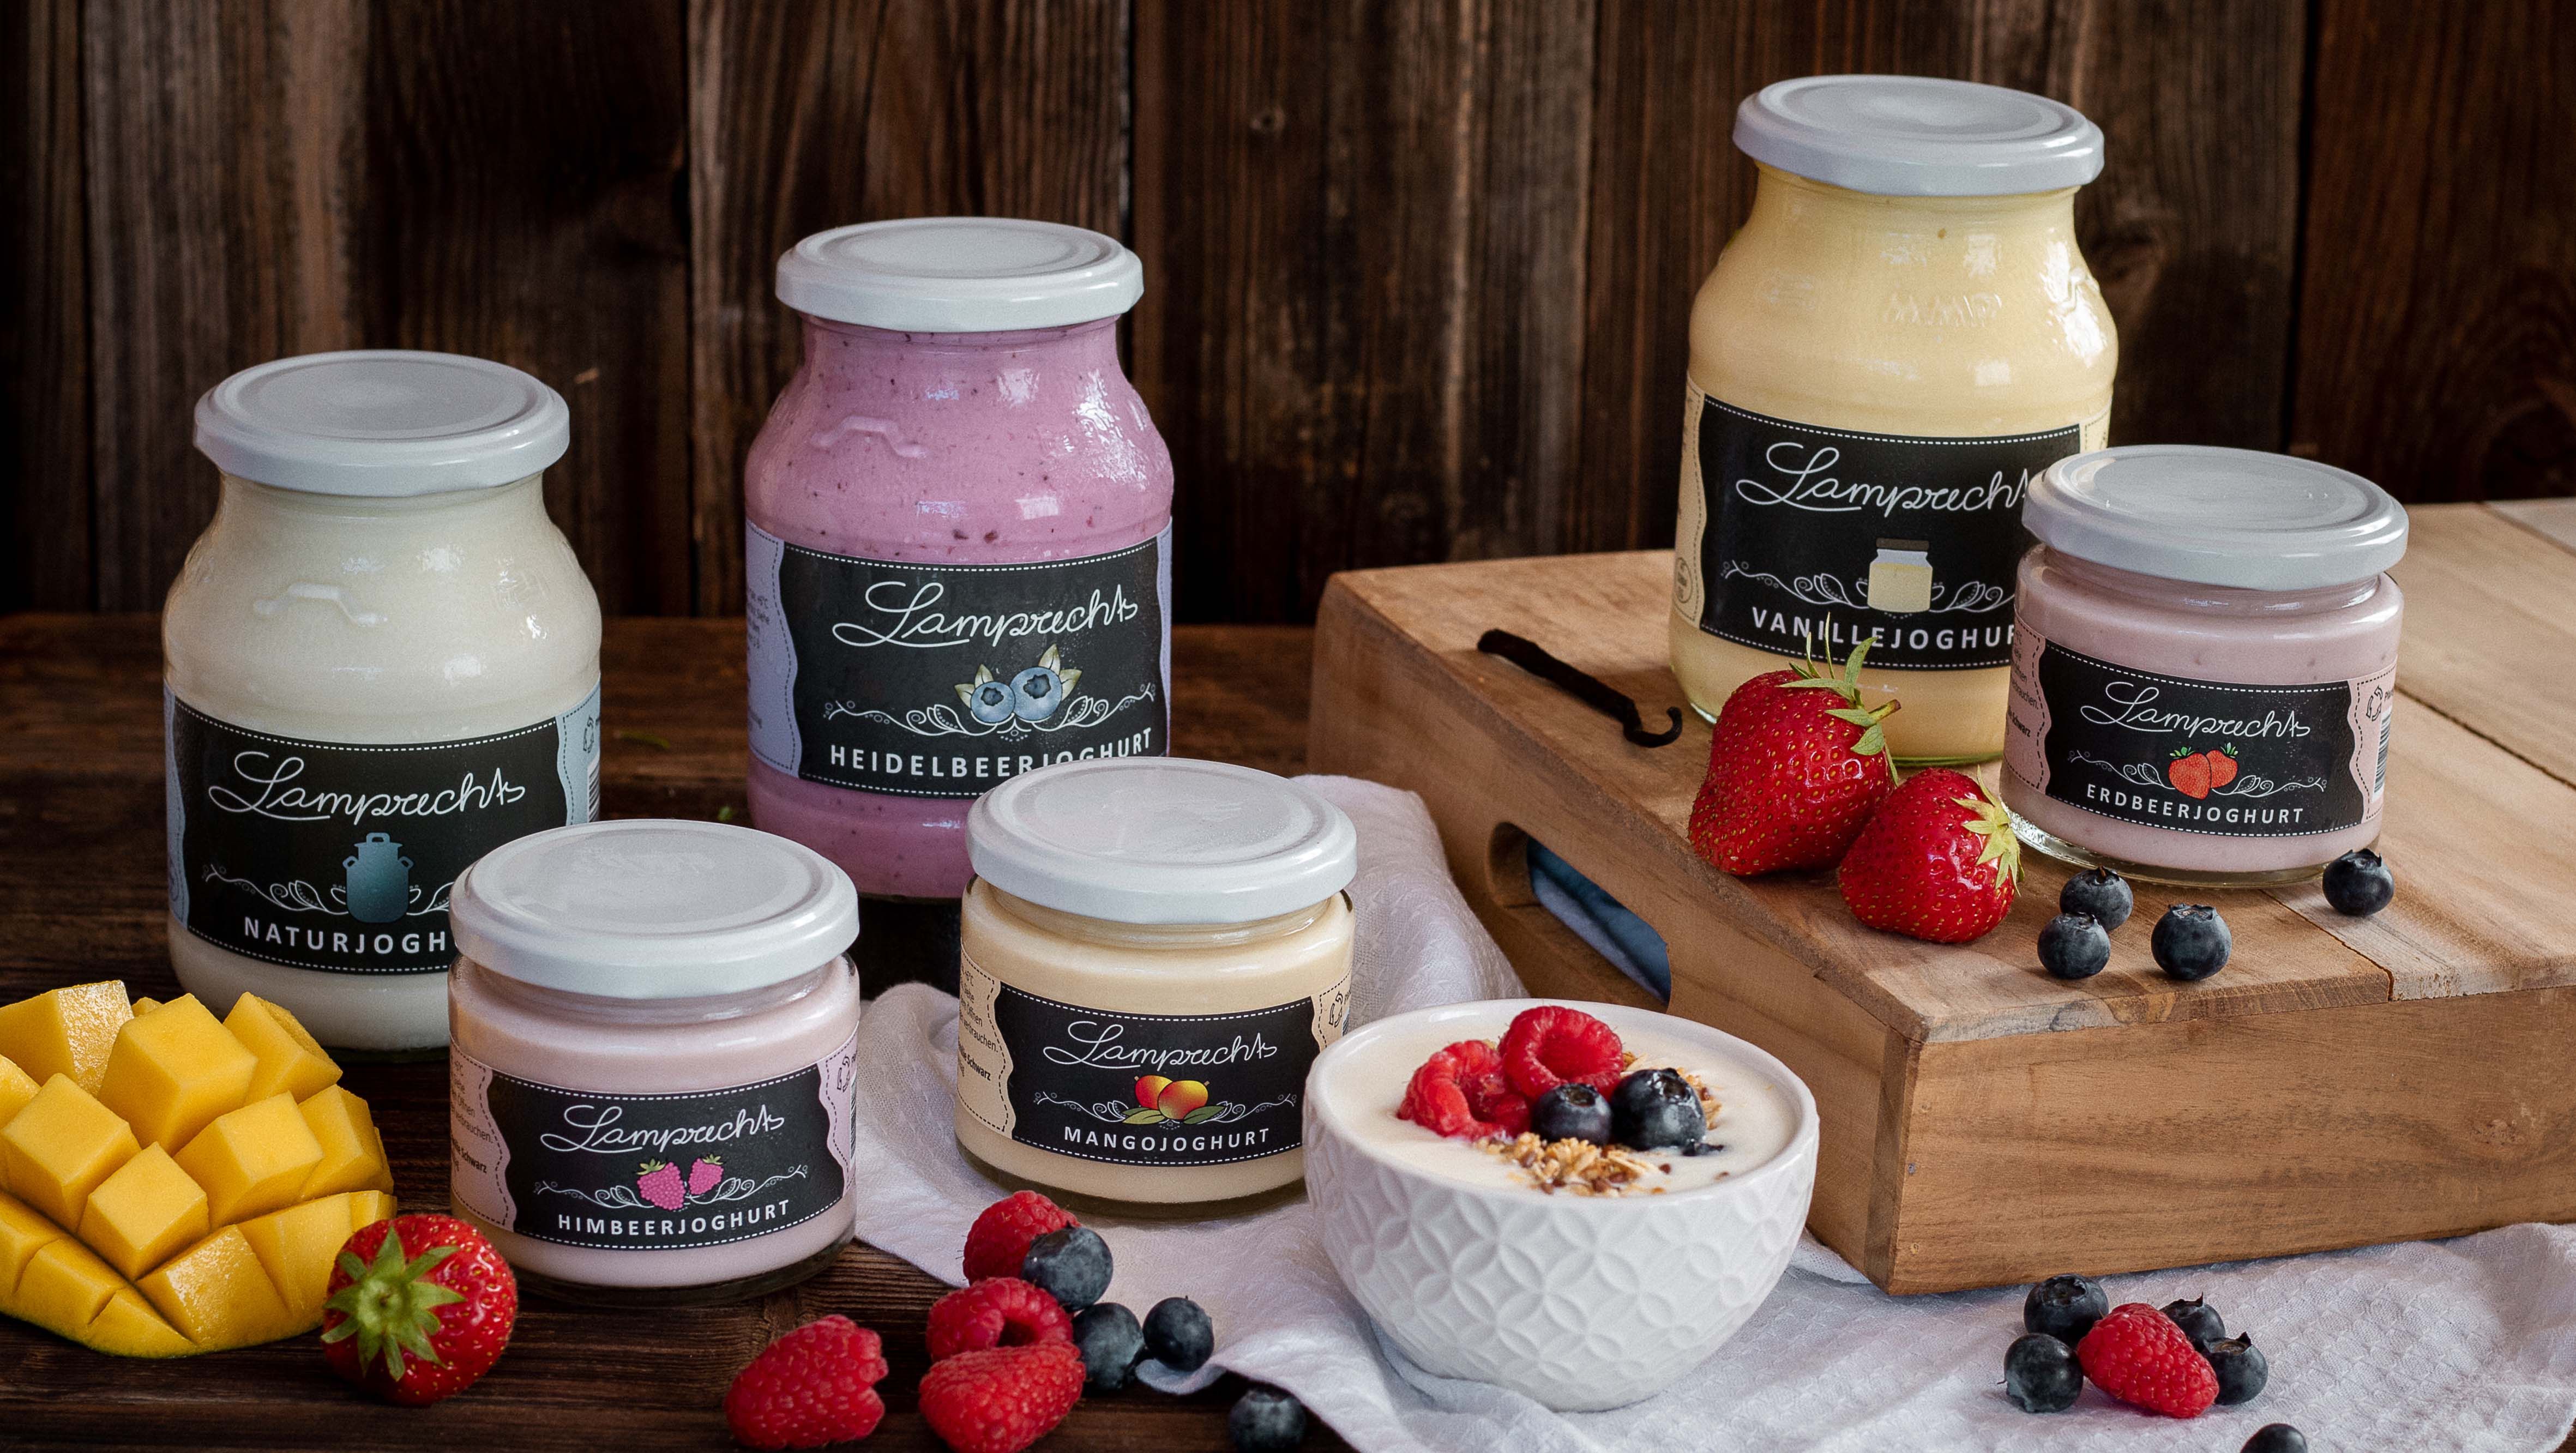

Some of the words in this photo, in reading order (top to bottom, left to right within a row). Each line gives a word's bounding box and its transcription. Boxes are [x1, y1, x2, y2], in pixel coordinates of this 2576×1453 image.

[1752, 606, 2014, 649] VANILLEJOGHU
[2086, 783, 2304, 824] ERDBEERJOGHURT
[244, 917, 446, 954] NATURJOGH
[967, 1054, 991, 1081] Schwarz
[1064, 1126, 1269, 1152] MANGOJOGHURT
[558, 1198, 790, 1236] HIMBEERJOGHURT
